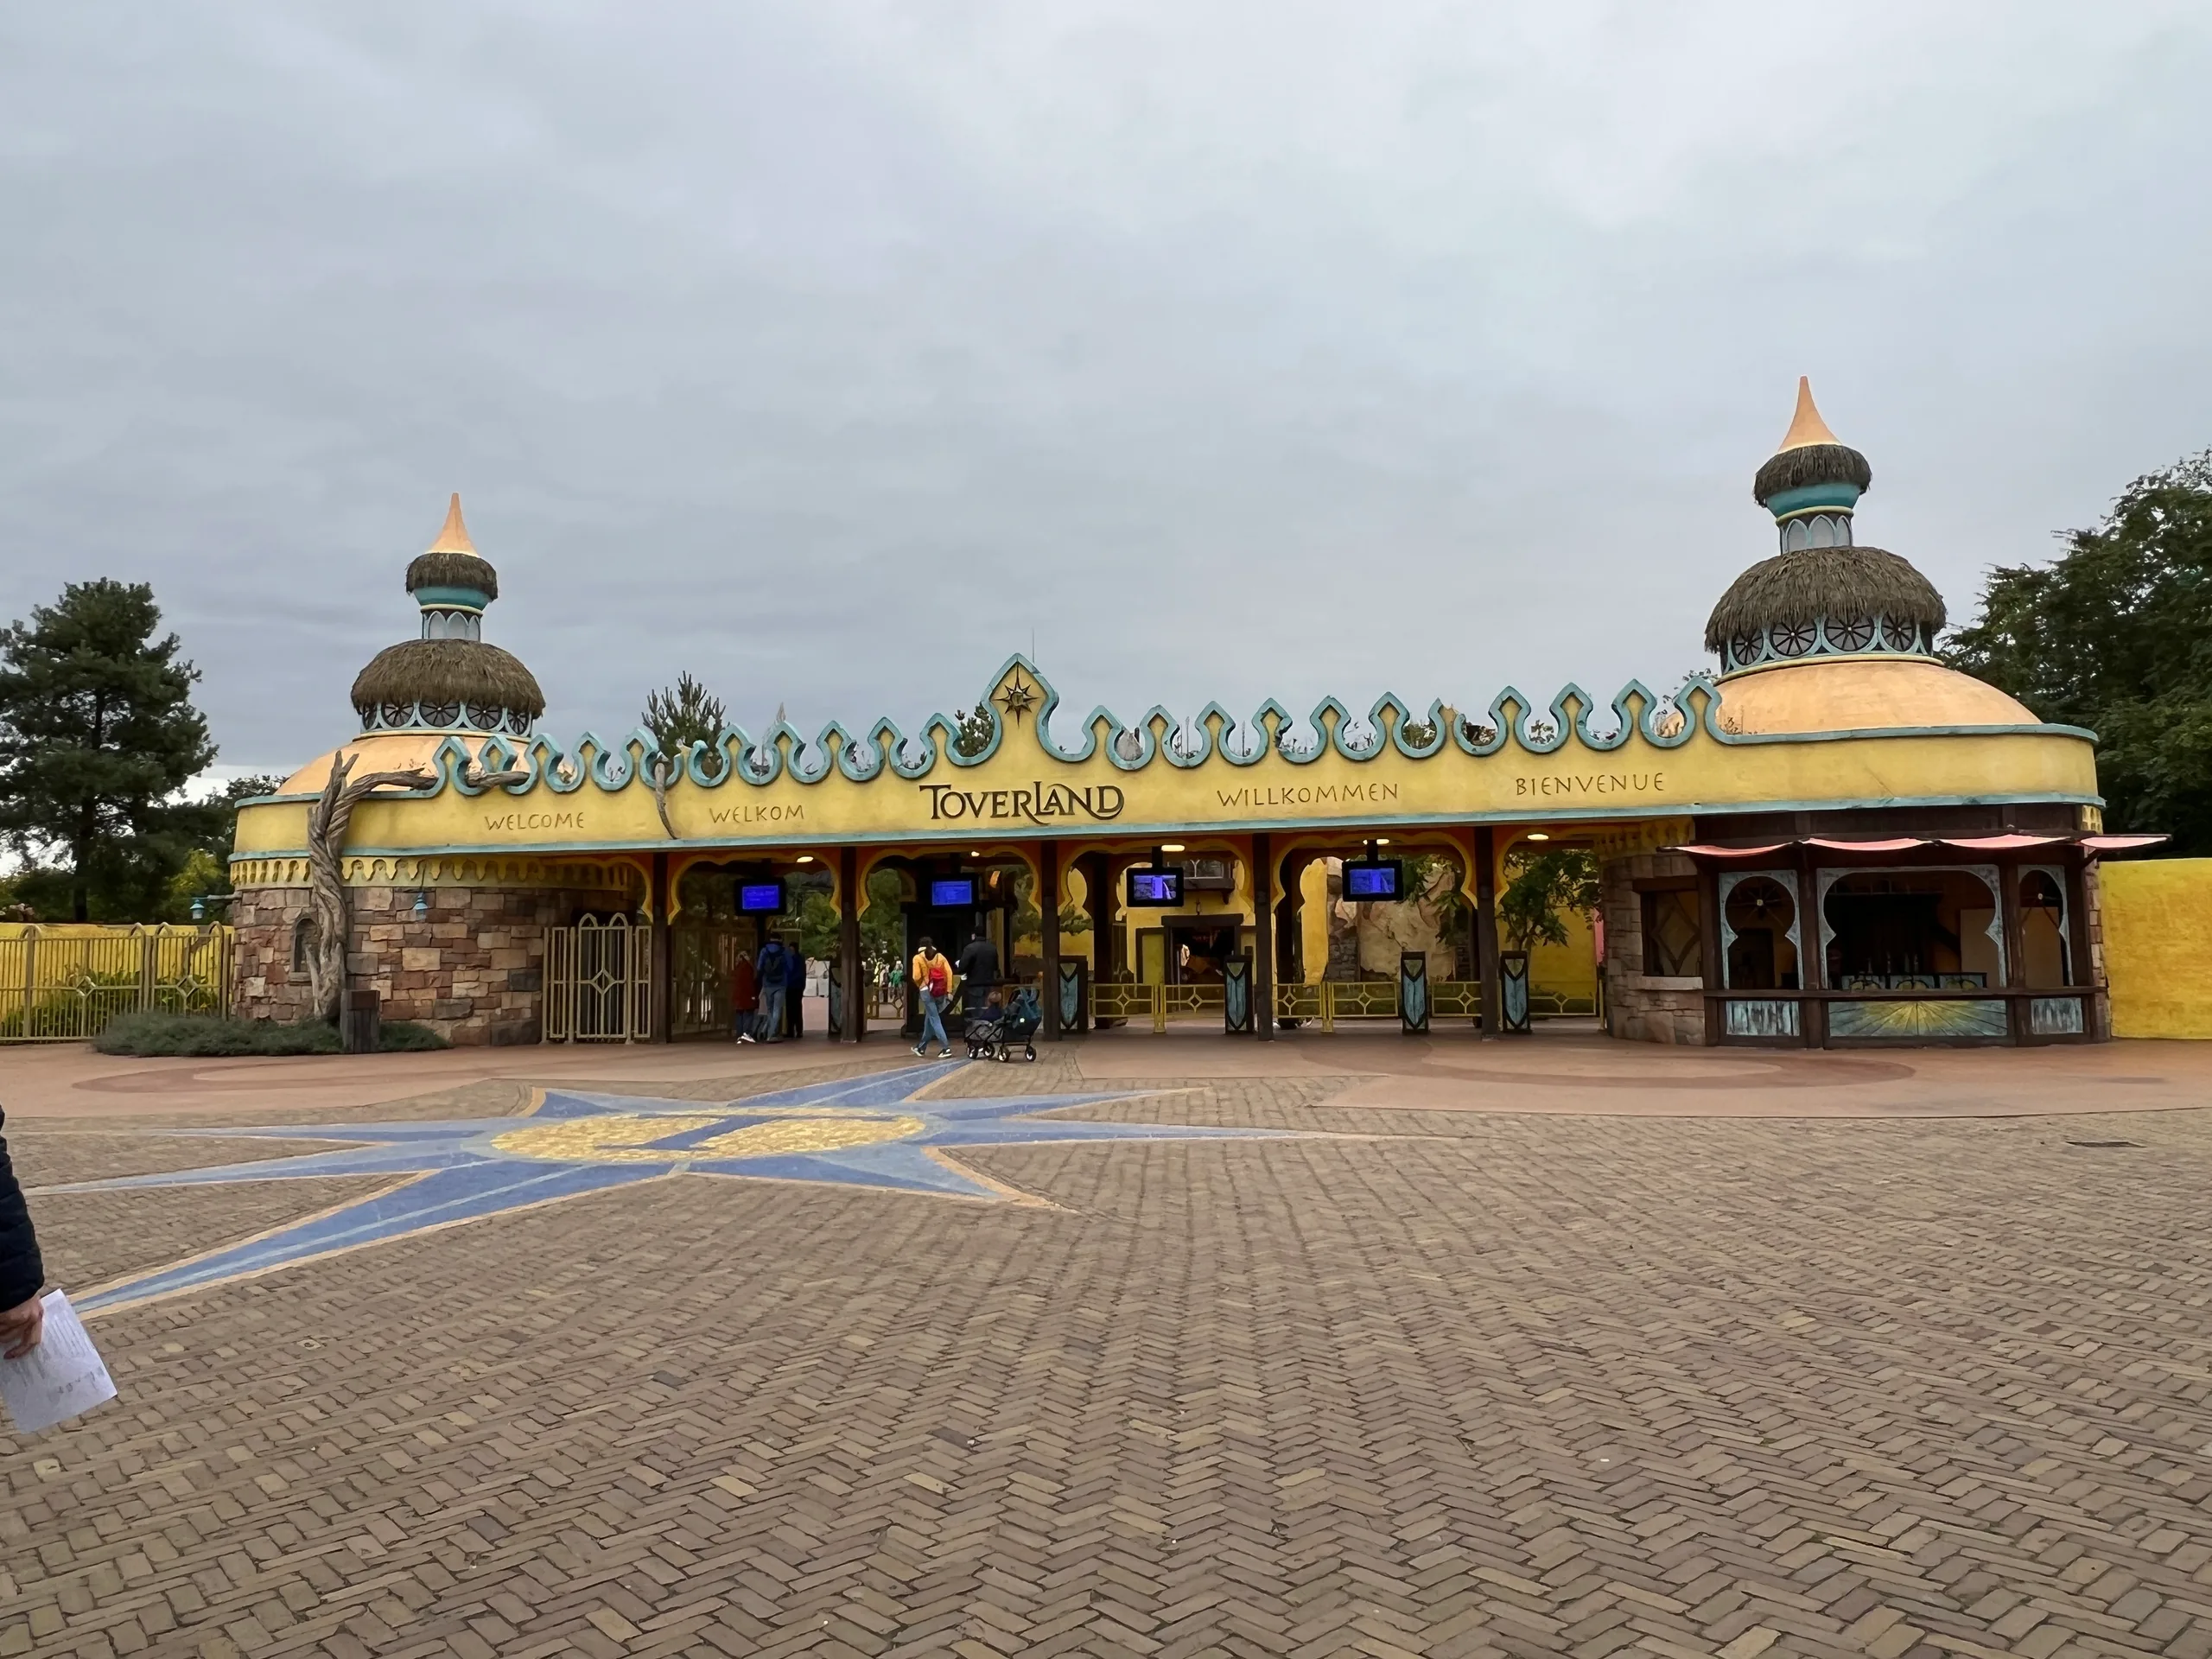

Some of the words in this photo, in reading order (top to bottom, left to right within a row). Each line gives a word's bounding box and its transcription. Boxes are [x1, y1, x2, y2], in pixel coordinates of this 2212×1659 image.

[1217, 783, 1398, 806] WILLKOMMEN
[1516, 772, 1665, 796] BIENVENUE
[709, 804, 804, 823] WELKOM
[918, 781, 1125, 825] TOVERLAND
[484, 812, 584, 830] WELCOME
